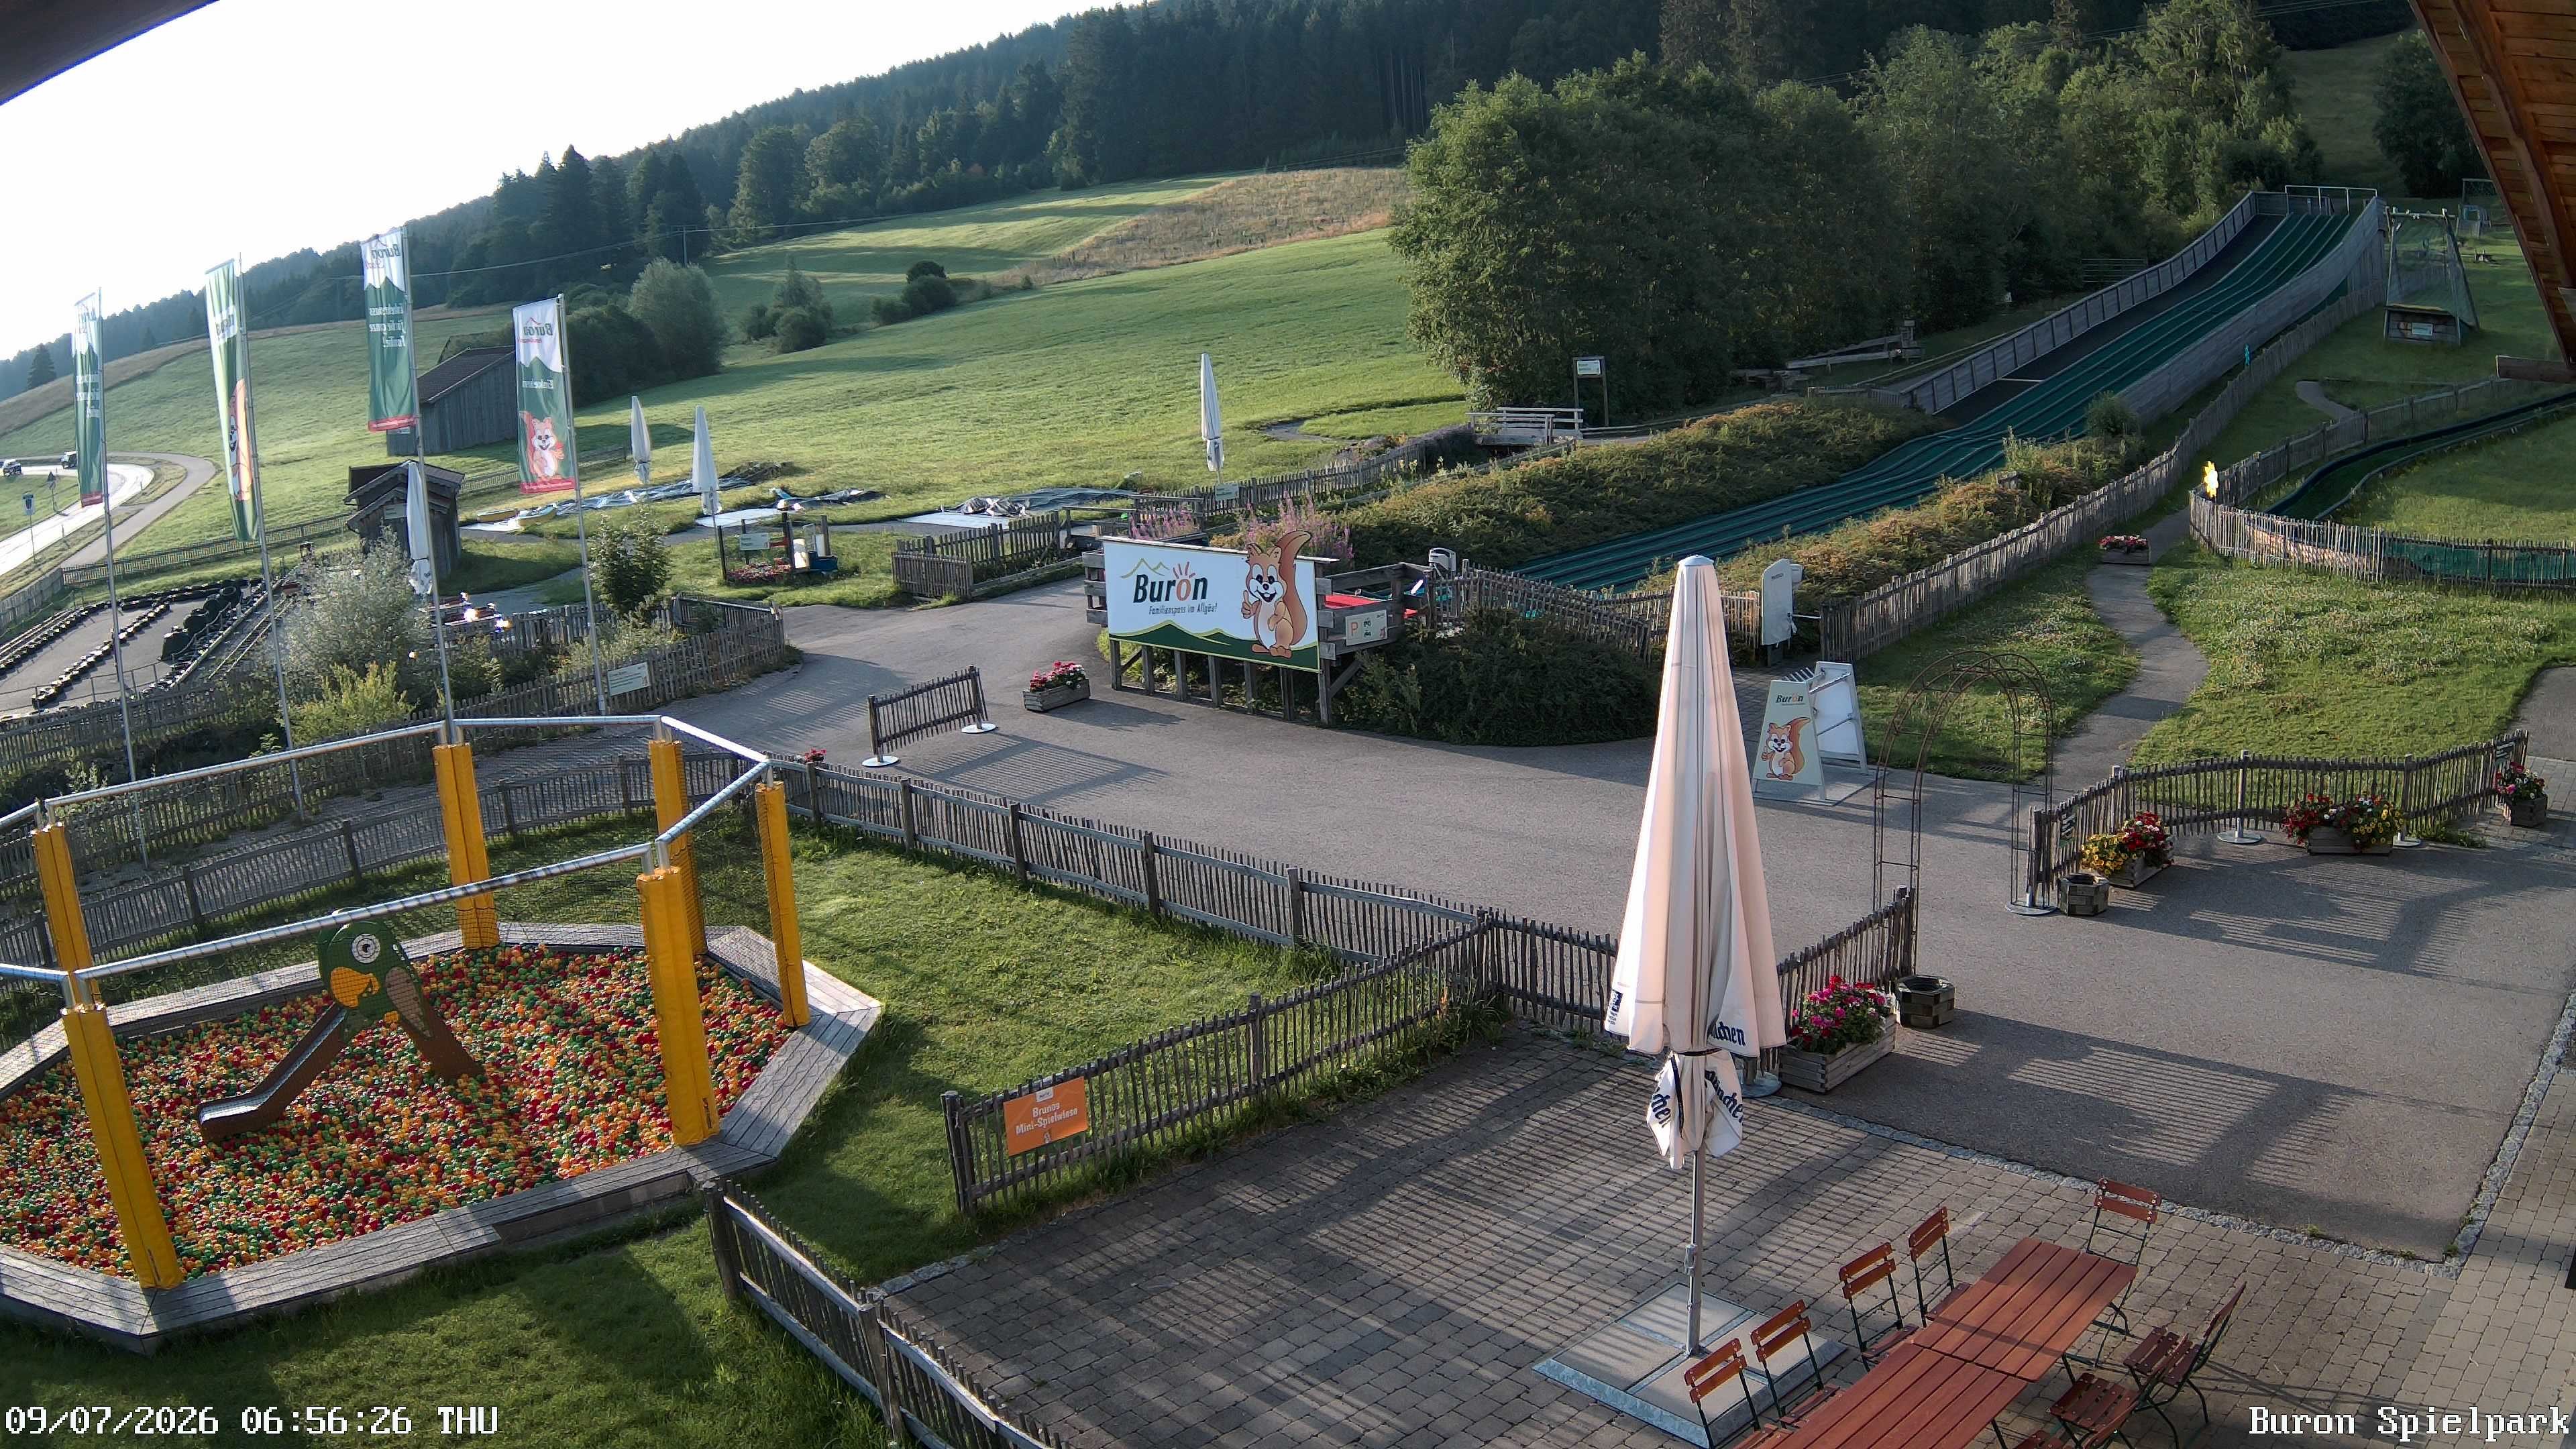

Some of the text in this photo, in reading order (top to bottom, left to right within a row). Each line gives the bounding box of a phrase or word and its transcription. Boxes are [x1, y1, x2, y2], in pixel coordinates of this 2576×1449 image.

[1133, 574, 1208, 603] Buron
[1187, 605, 1195, 613] im
[1351, 621, 1358, 637] P
[1776, 694, 1804, 703] Buron
[1032, 1102, 1061, 1118] Brunos
